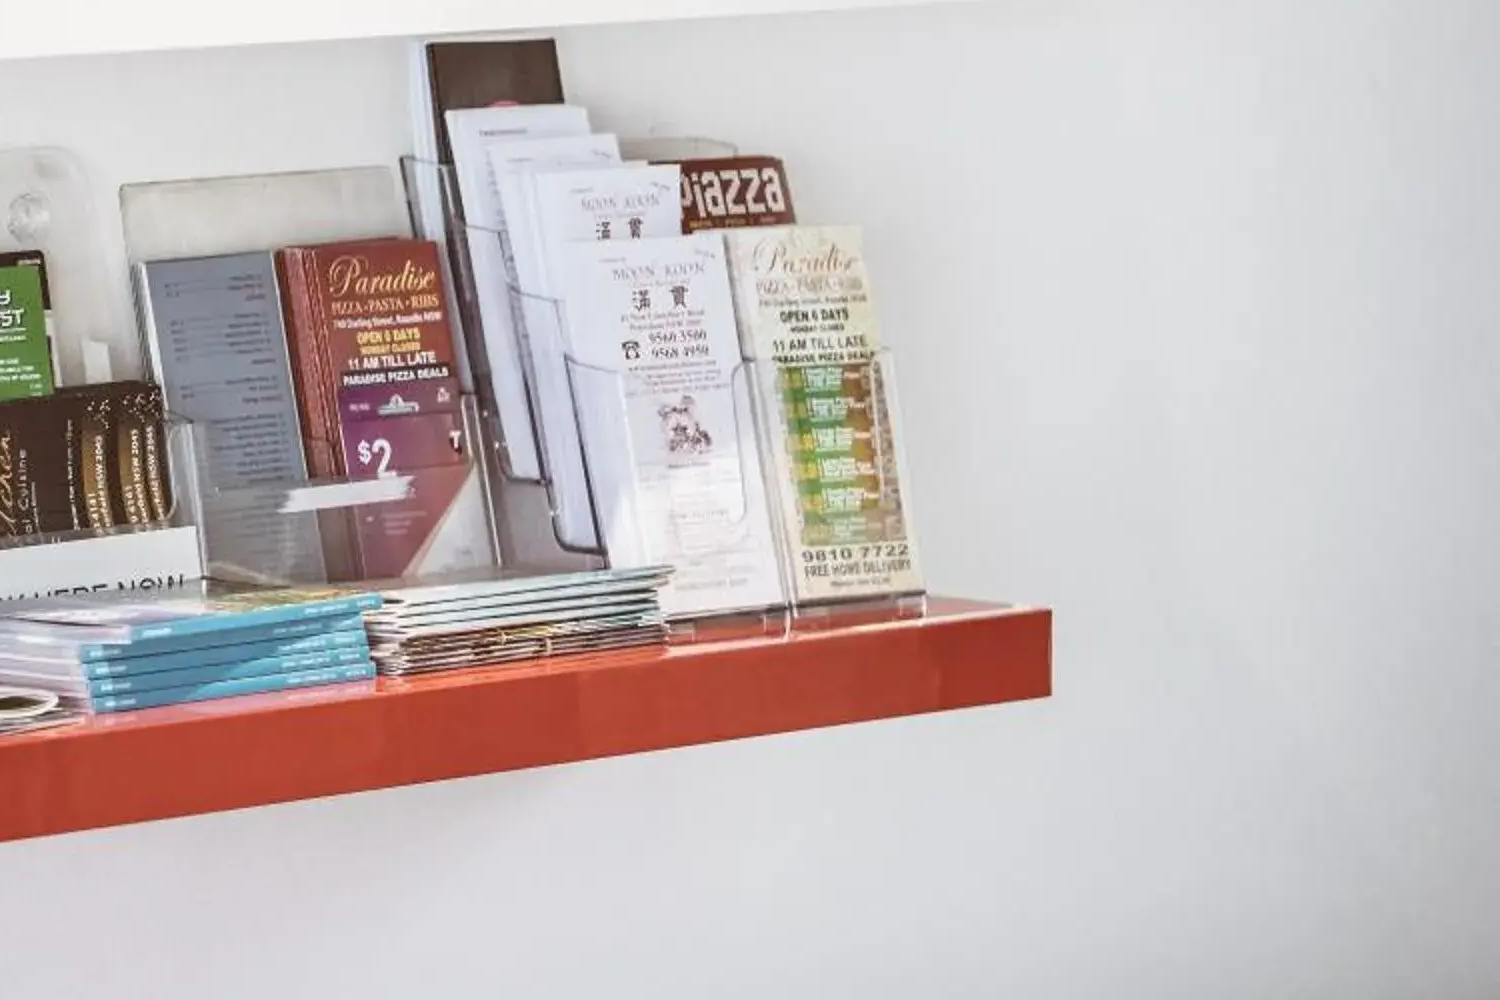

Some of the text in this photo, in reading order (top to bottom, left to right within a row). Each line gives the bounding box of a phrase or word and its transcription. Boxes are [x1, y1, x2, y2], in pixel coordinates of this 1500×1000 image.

[753, 237, 860, 273] Paradise
[329, 255, 436, 298] Paradise
[332, 295, 439, 315] PIZZA PASTA RIBS
[780, 310, 809, 323] OPEN
[821, 307, 849, 321] DAYS
[356, 330, 383, 345] OPEN
[394, 328, 420, 341] DAYS
[773, 334, 868, 353] 11 AM TILL LATE
[363, 357, 380, 369] AM
[383, 355, 403, 367] TILL
[408, 351, 437, 366] LATE
[772, 353, 816, 364] PARADISE
[818, 352, 845, 362] PIZZA
[343, 367, 449, 386] PARADISE PIZZA DEALS
[357, 438, 397, 480] $2
[17, 448, 31, 511] Cuisine
[802, 543, 910, 563] 9810 7722
[804, 563, 830, 578] FREE
[863, 559, 911, 575] DELIVERY
